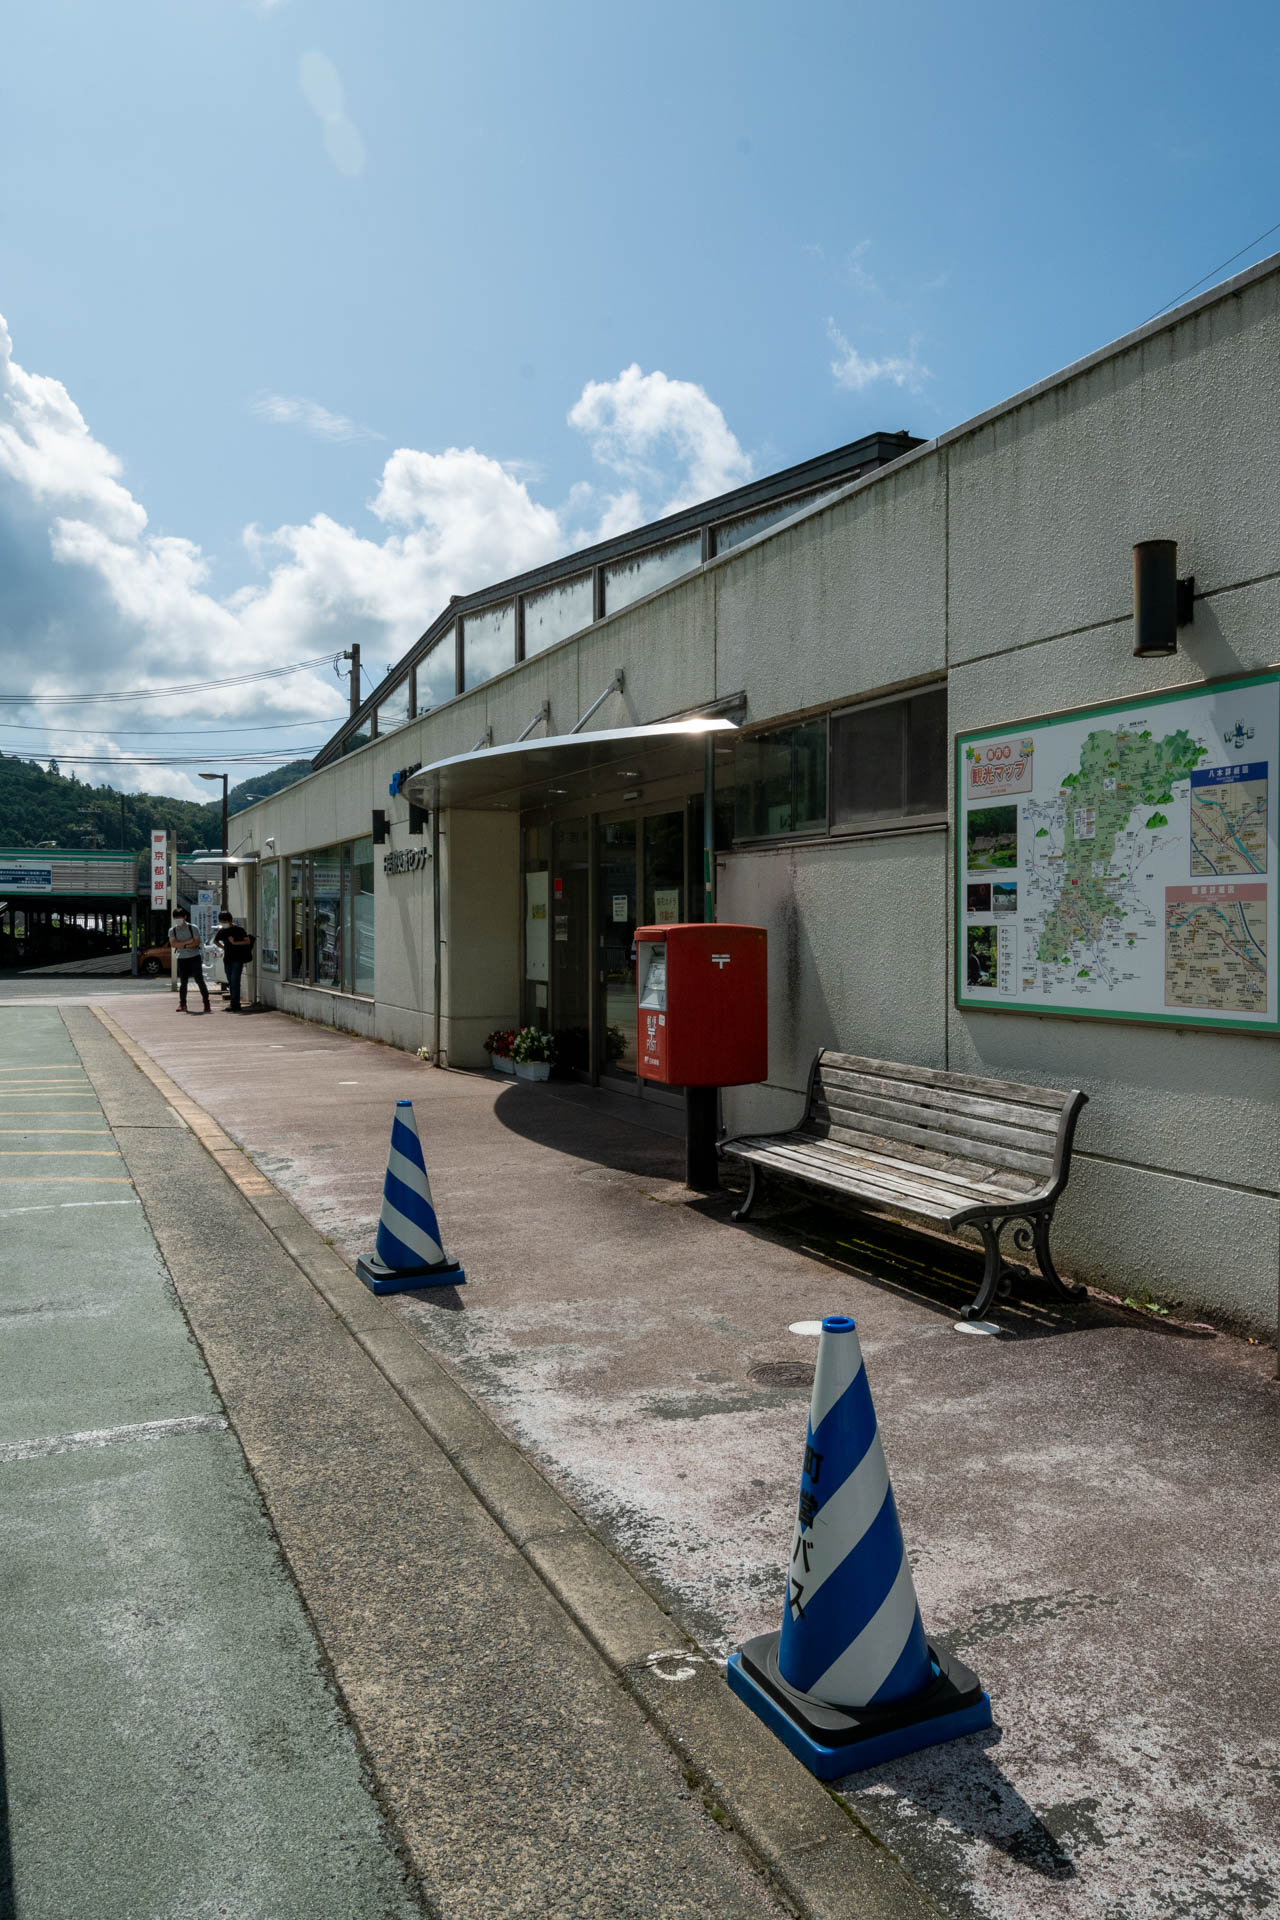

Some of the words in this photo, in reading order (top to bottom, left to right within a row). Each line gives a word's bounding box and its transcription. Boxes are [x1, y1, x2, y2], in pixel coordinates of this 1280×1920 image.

[971, 757, 1028, 787] 観光マップ
[153, 851, 165, 906] 京都銀行
[788, 1445, 824, 1618] 町営バス
